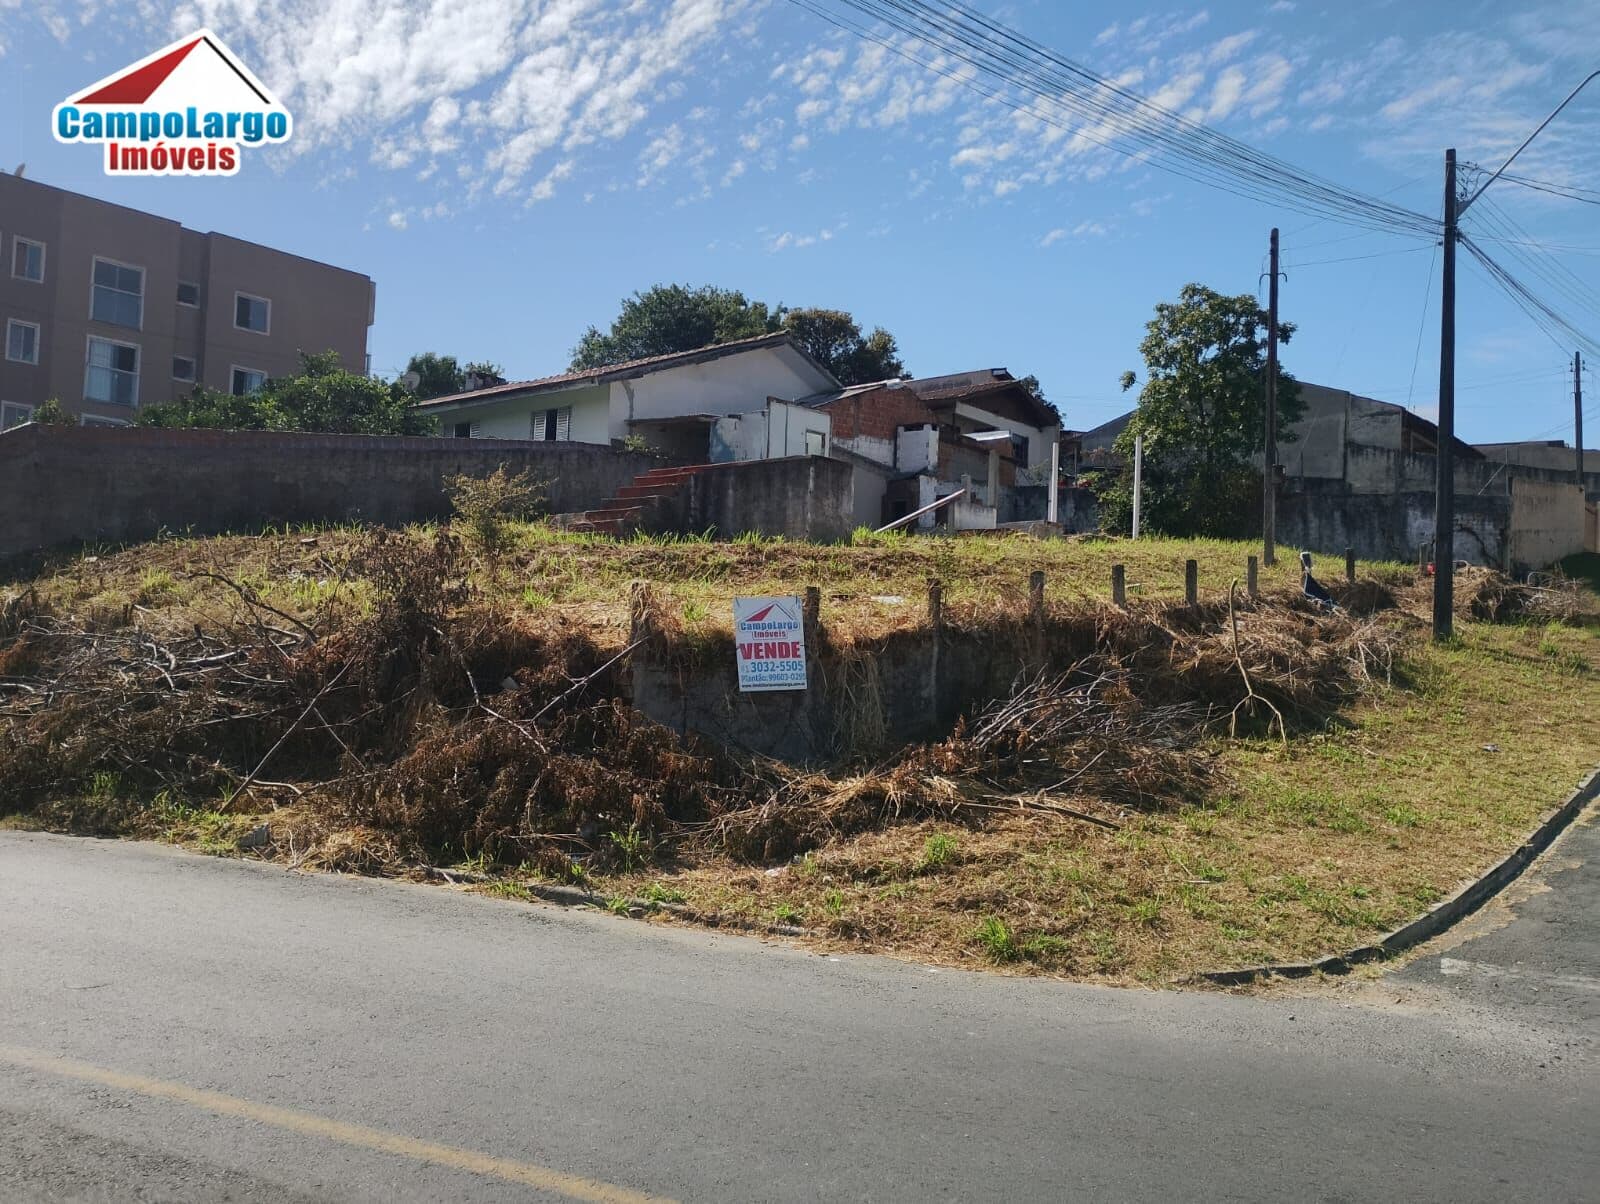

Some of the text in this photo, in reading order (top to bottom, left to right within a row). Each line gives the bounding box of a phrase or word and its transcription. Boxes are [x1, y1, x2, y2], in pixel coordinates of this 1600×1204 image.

[740, 621, 799, 631] CampoLargo
[754, 630, 786, 638] Imóveis
[739, 641, 802, 660] VENDE
[750, 660, 804, 673] 3032-5505
